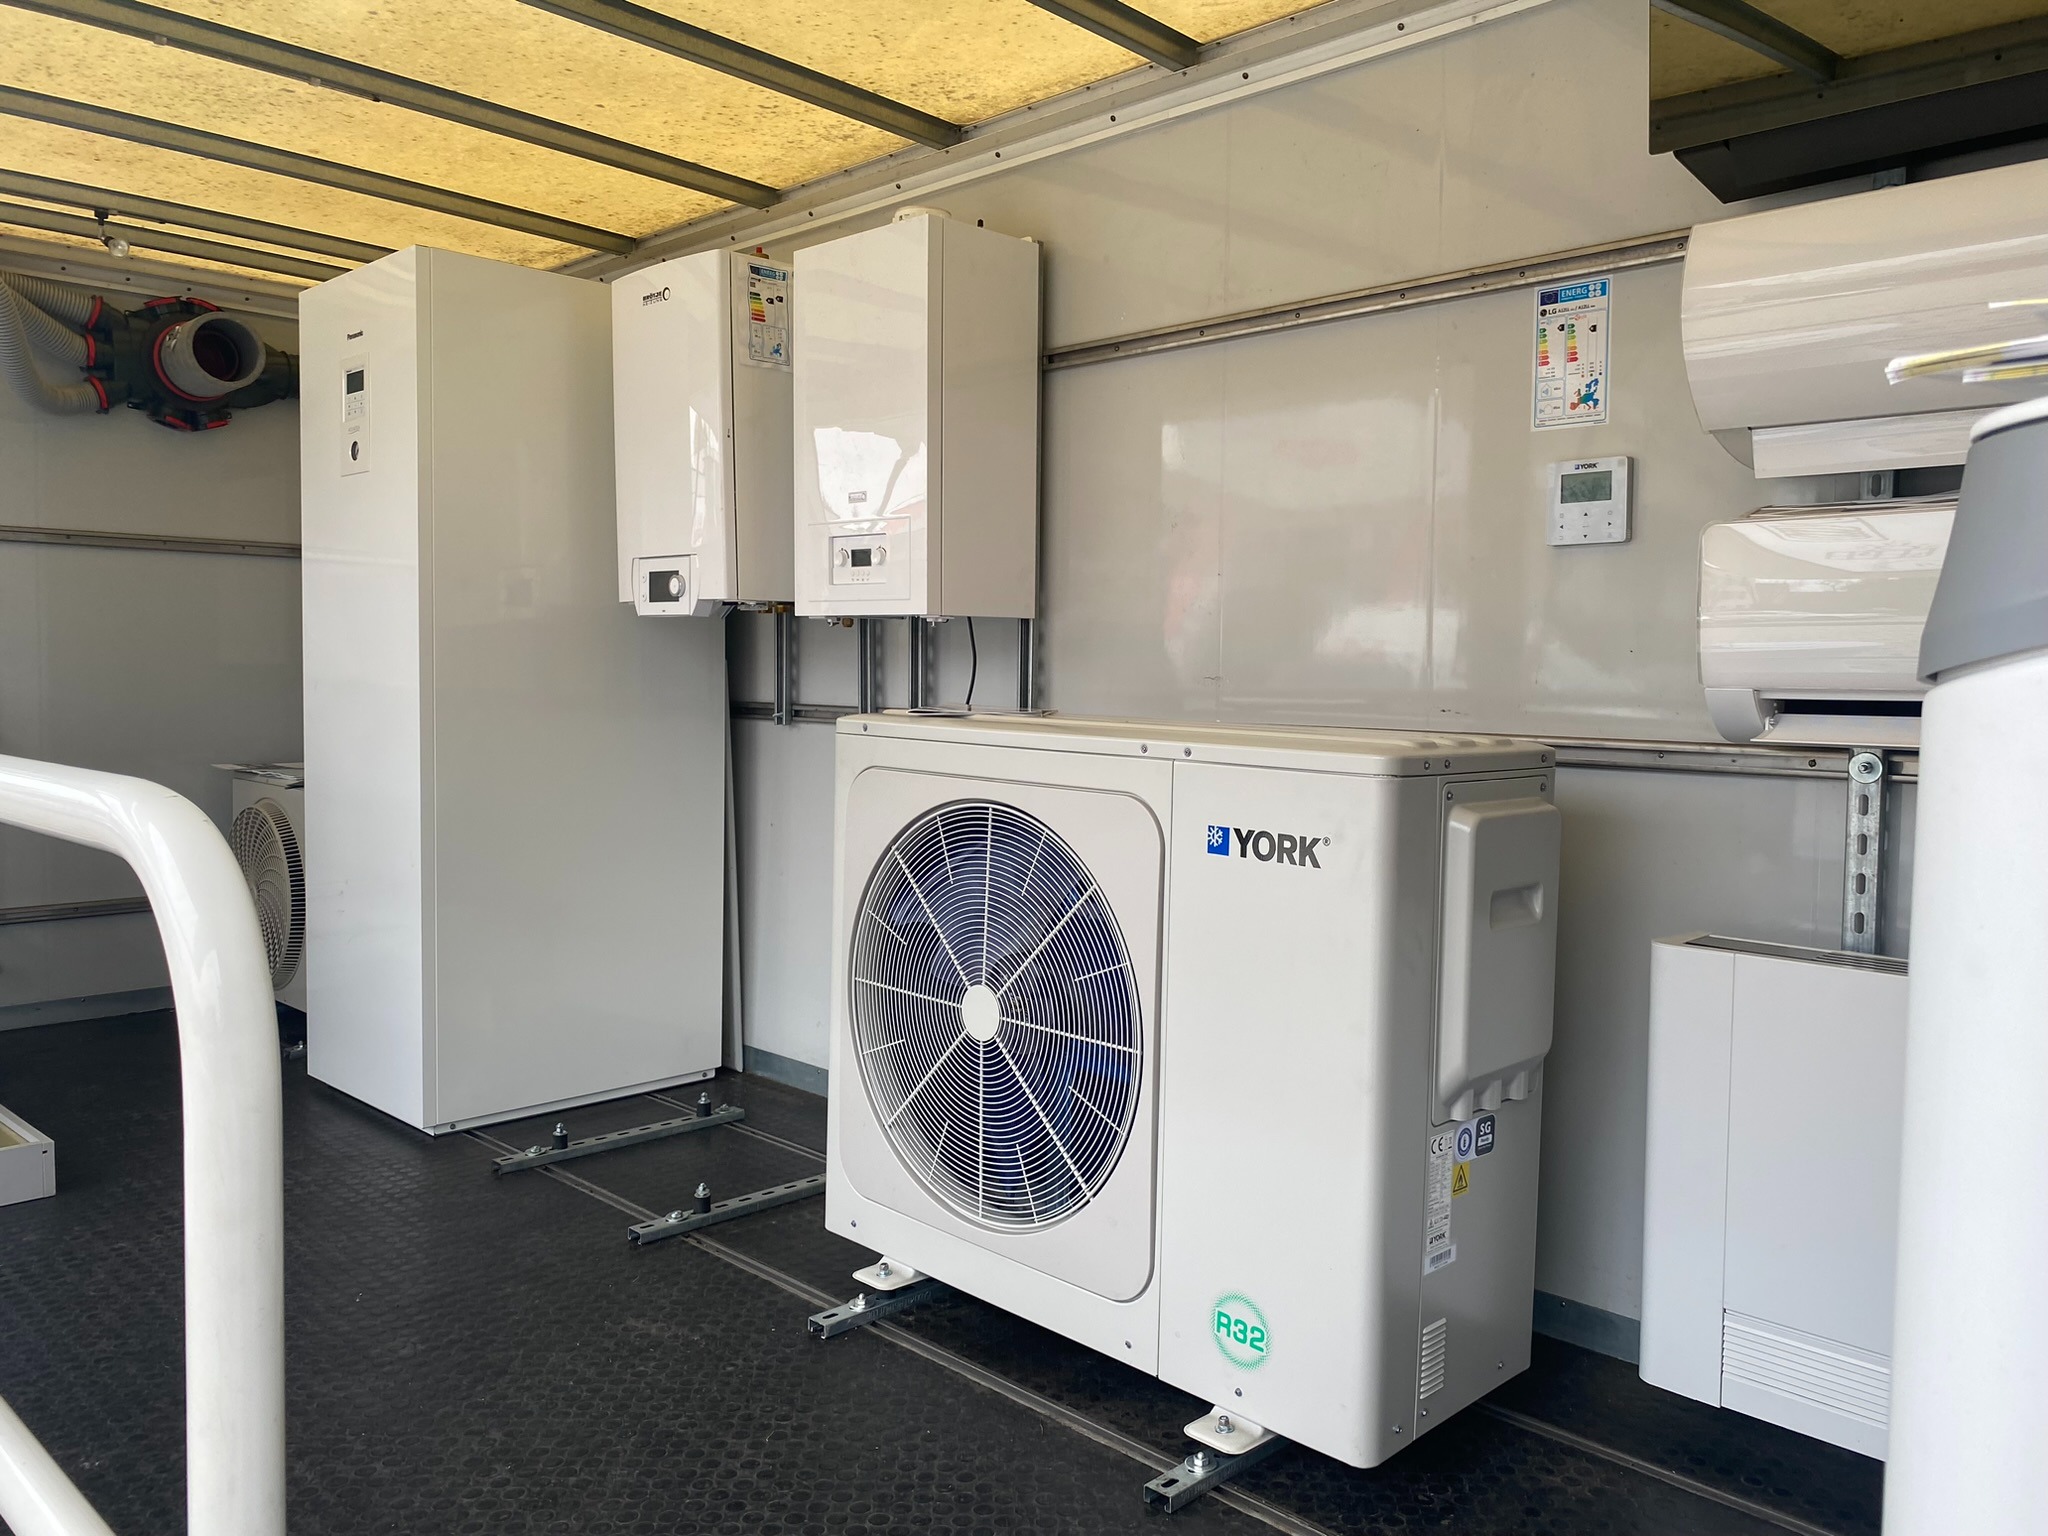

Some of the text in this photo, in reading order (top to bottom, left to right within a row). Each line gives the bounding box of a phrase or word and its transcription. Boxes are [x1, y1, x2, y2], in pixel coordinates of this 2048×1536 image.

[1561, 287, 1588, 298] ENERG
[1480, 1121, 1491, 1135] SG
[1431, 1136, 1444, 1154] CE
[1216, 1310, 1265, 1353] R32
